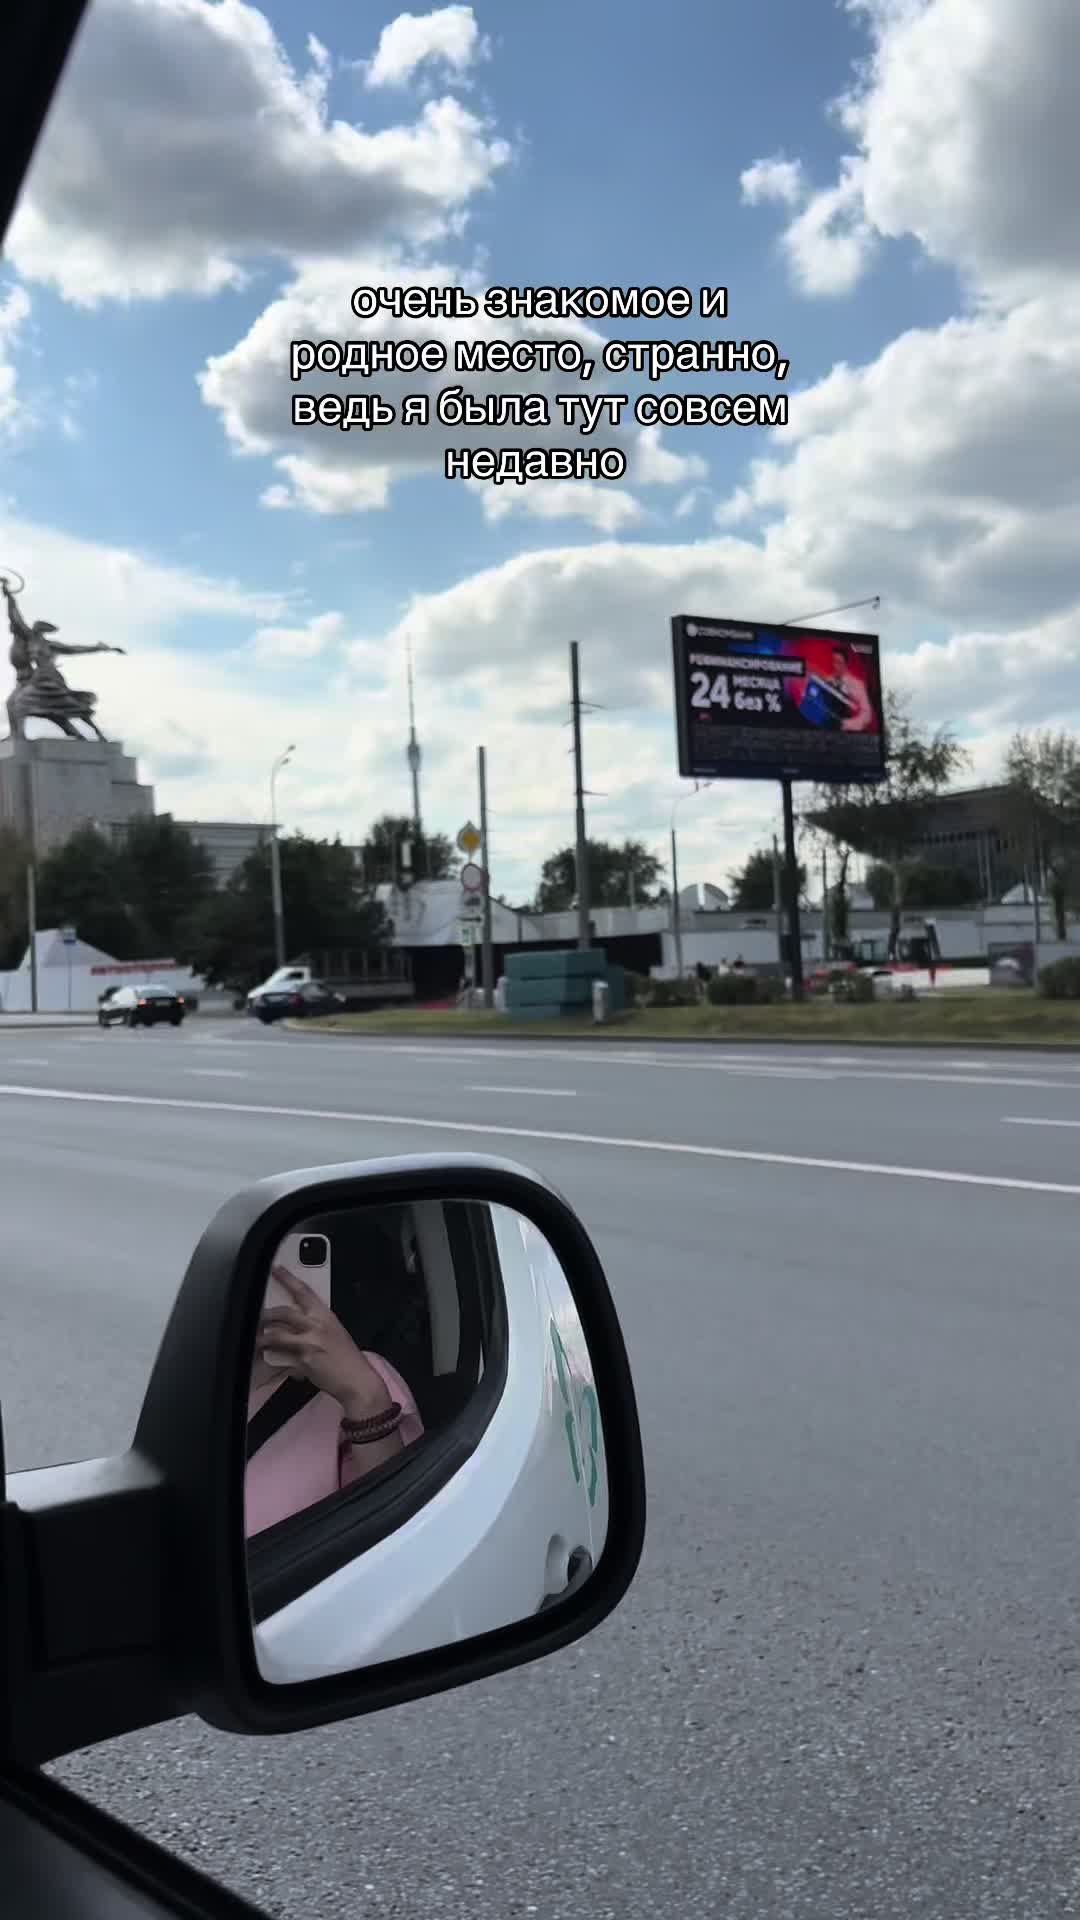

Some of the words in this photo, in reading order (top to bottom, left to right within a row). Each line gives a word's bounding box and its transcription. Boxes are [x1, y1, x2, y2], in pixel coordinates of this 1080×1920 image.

[690, 672, 730, 709] 24
[733, 691, 763, 711] без
[764, 693, 782, 713] %
